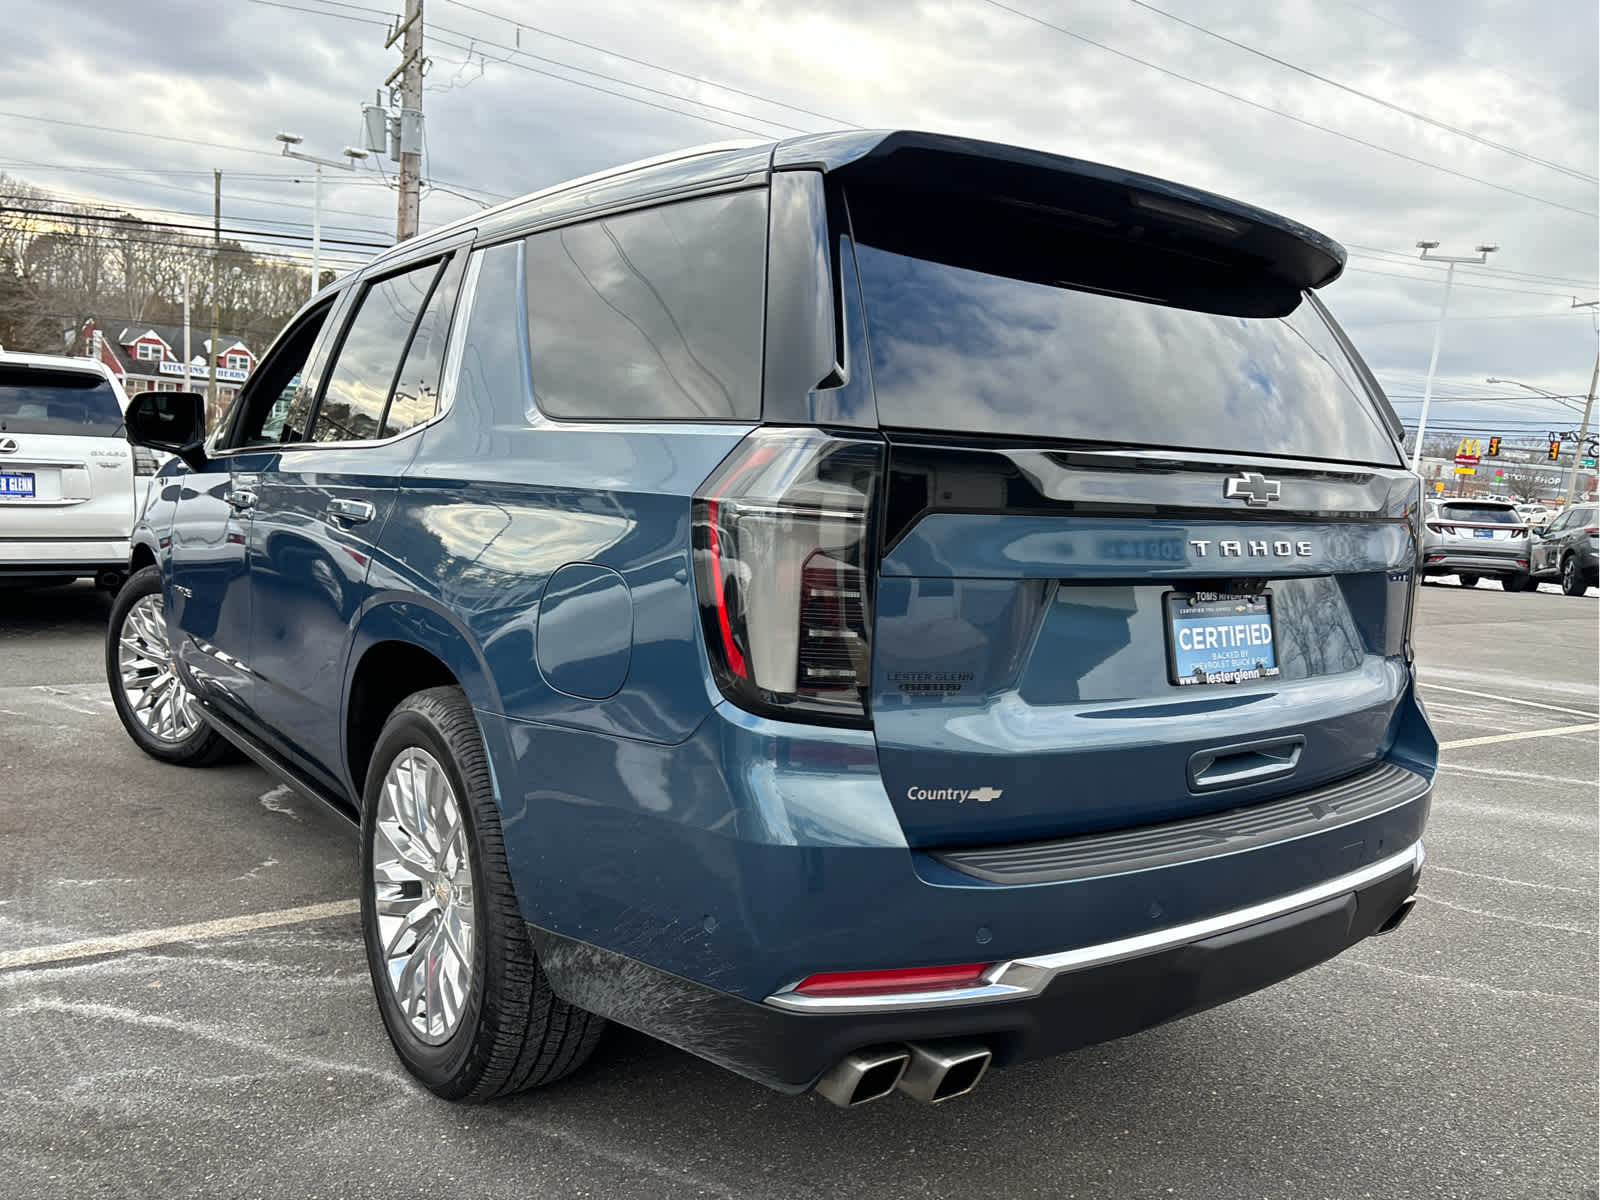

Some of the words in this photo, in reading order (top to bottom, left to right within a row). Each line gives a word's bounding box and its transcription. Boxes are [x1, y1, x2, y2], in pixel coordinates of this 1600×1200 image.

[163, 363, 205, 375] VITAINS
[217, 369, 247, 379] HERBS
[1189, 540, 1313, 557] TAHOE
[1196, 591, 1218, 601] TOMS
[1178, 623, 1273, 651] CERTIFIED
[887, 672, 930, 681] LESTER
[907, 786, 968, 803] Country
